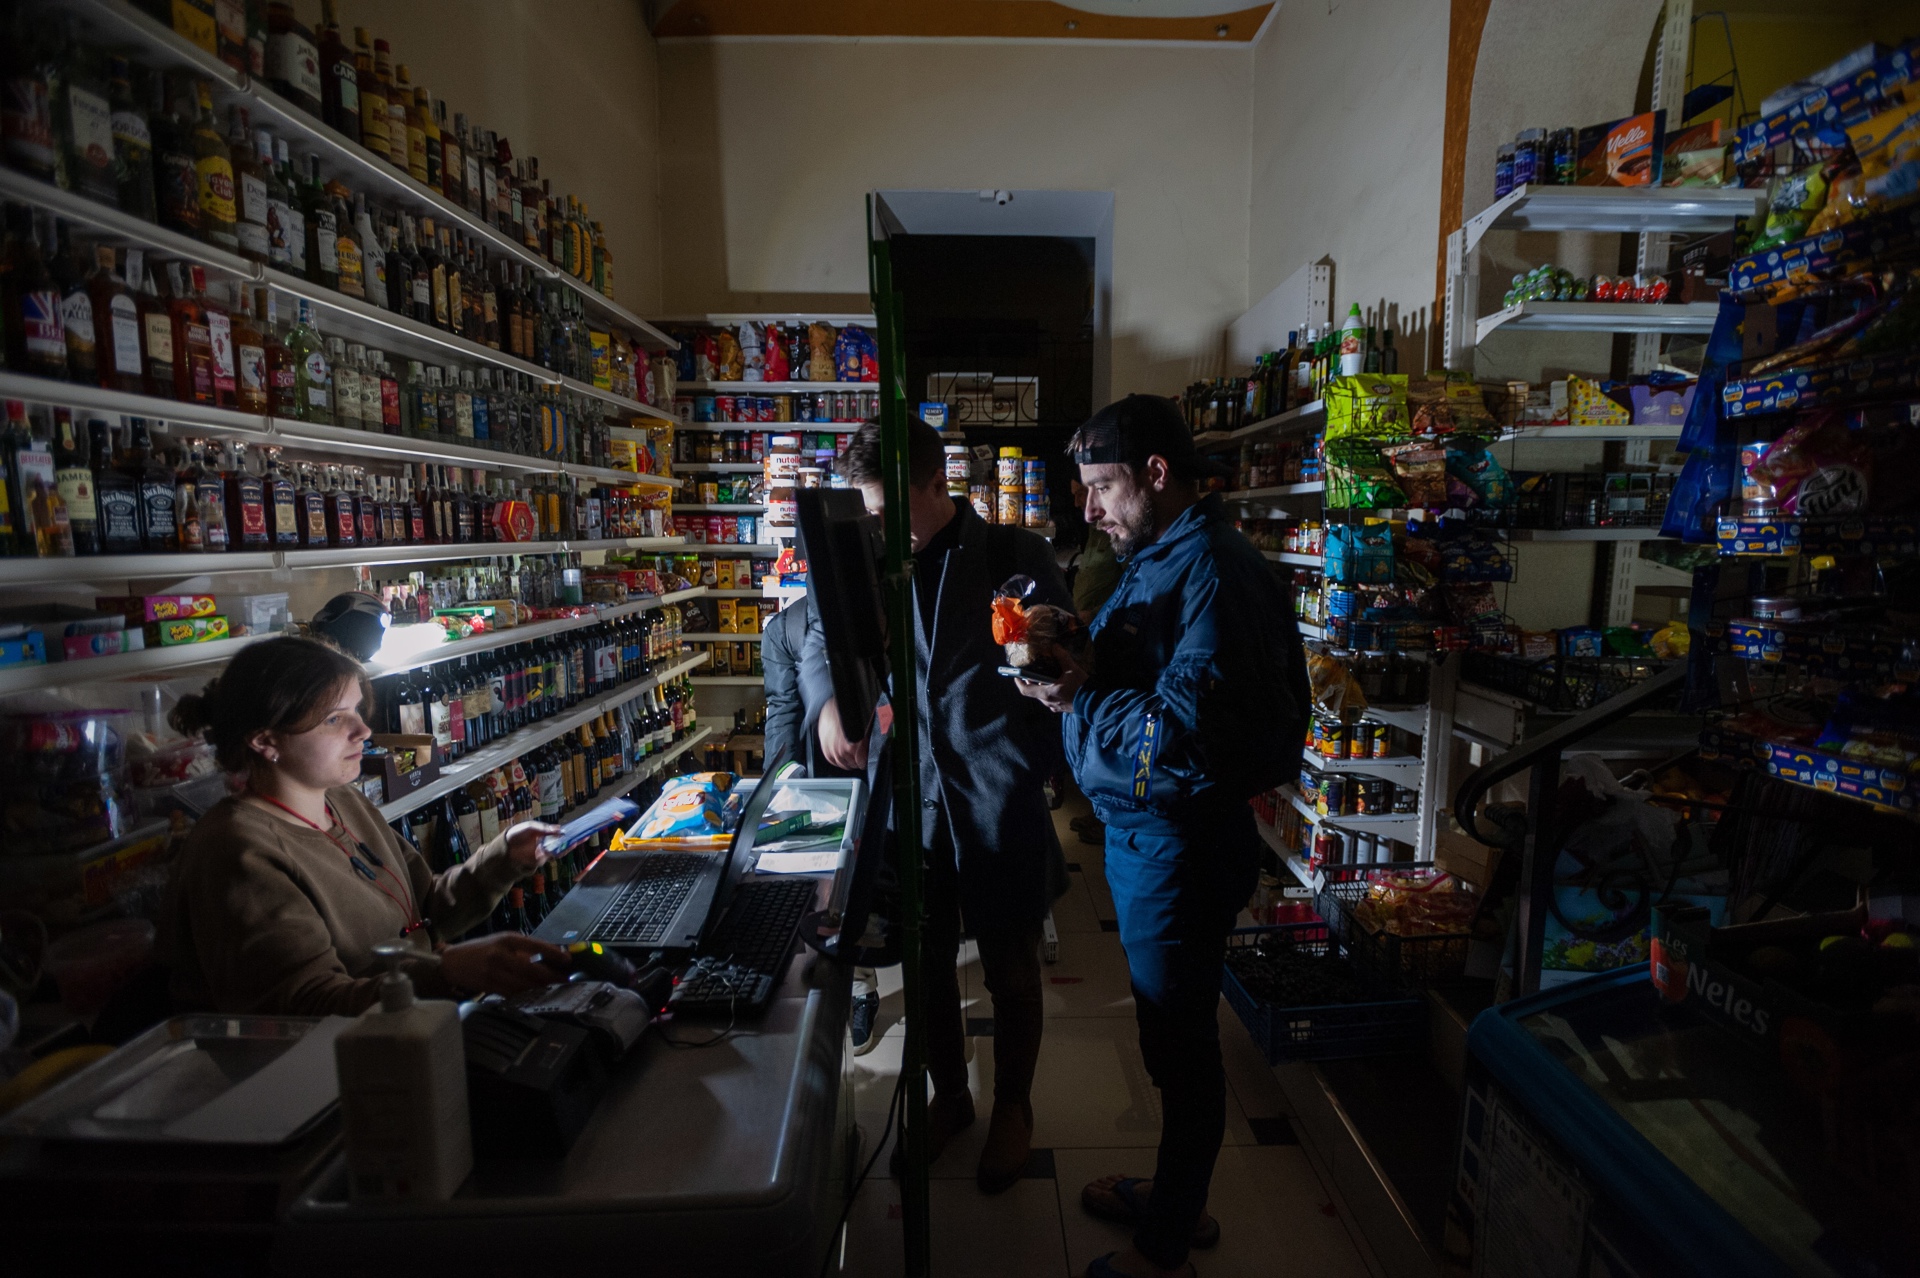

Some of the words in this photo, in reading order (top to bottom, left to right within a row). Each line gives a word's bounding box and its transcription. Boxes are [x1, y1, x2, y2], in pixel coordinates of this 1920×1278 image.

[1606, 125, 1647, 154] Mella
[1665, 930, 1688, 956] Les
[1685, 961, 1770, 1036] Neles
